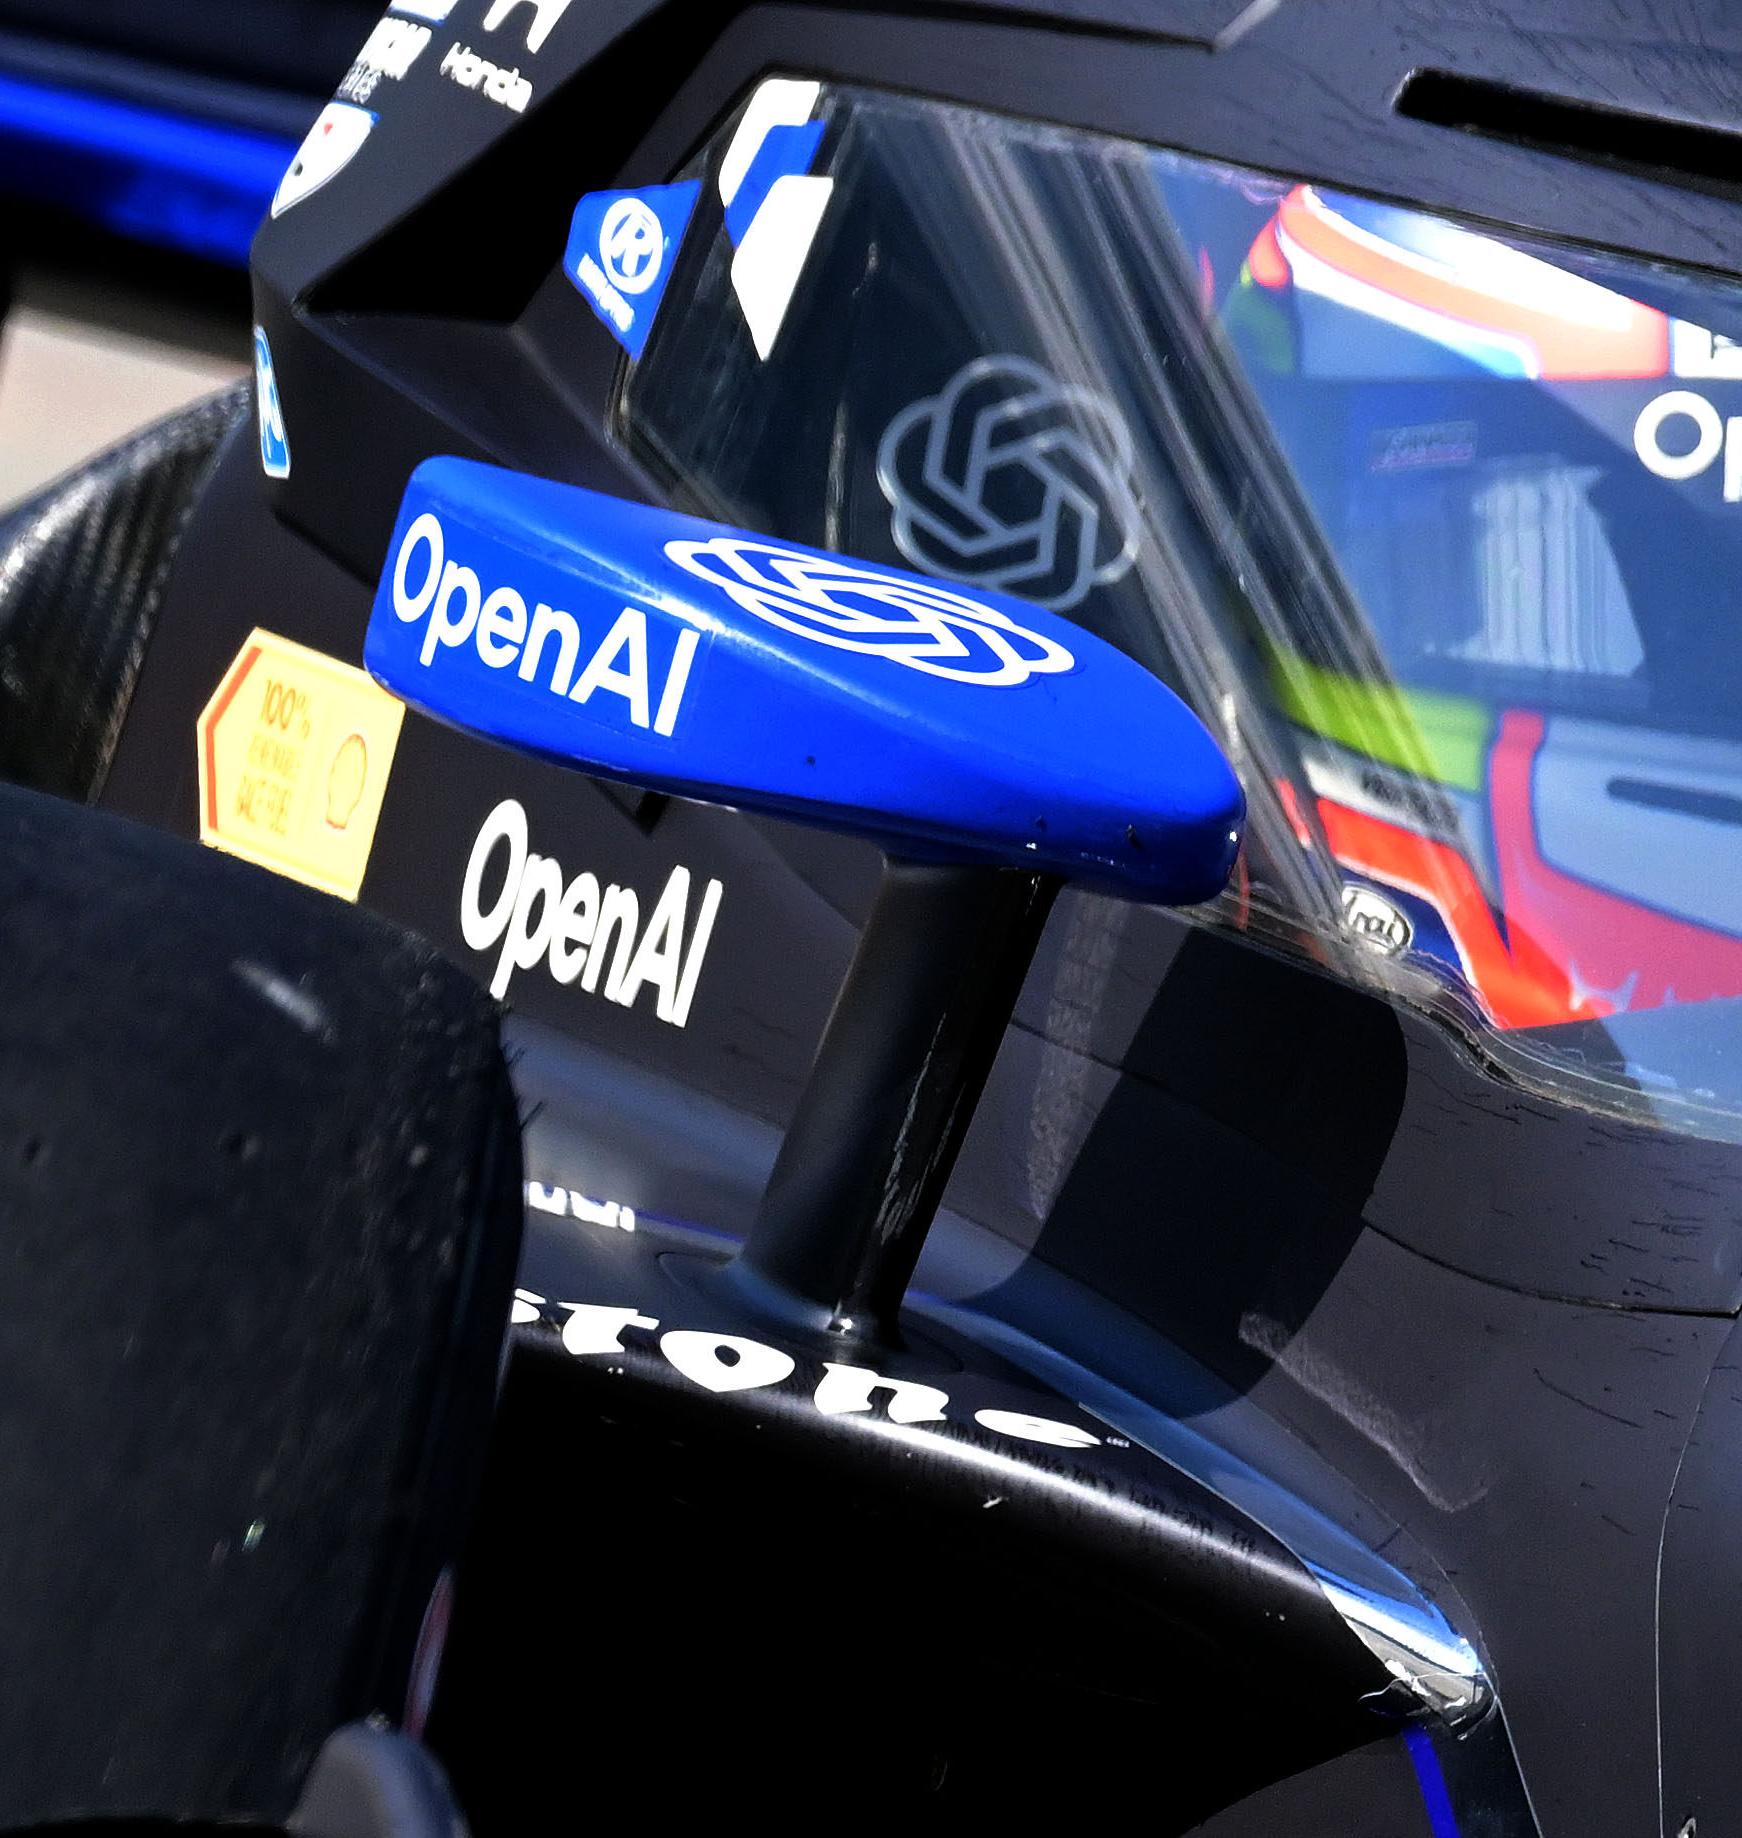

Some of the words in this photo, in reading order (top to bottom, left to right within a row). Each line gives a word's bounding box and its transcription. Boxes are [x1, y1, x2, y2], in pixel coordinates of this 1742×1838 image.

[440, 41, 533, 114] Honda
[392, 511, 700, 737] OpenAI
[461, 798, 724, 1029] OpenAI
